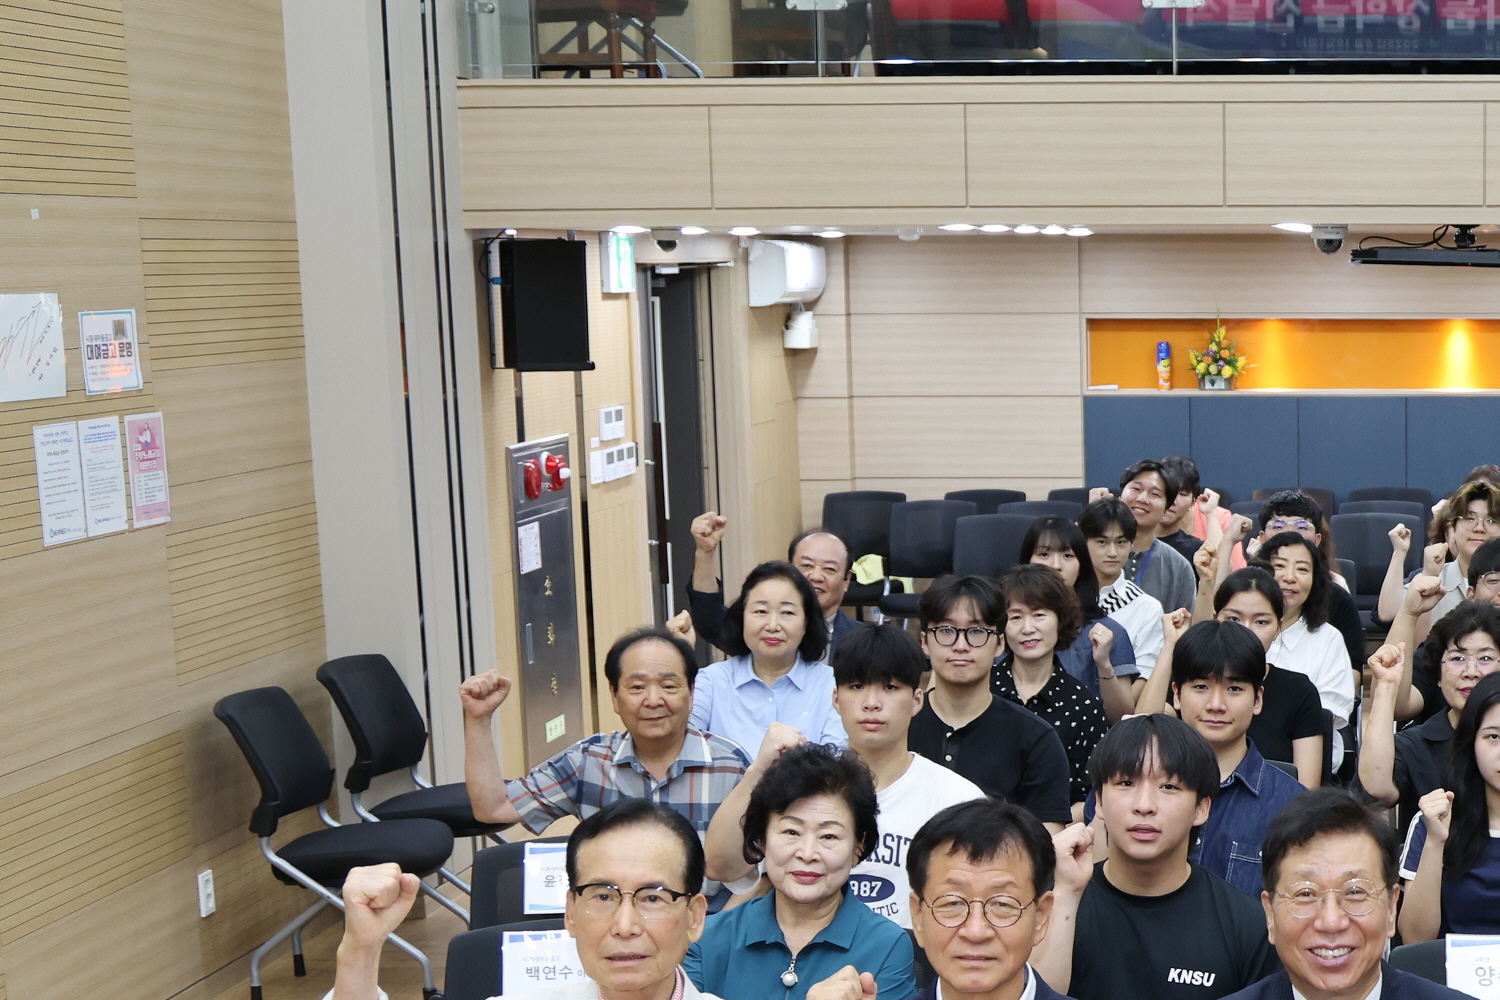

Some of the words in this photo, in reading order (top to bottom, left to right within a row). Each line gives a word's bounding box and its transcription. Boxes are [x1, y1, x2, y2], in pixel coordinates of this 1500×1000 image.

[118, 341, 133, 357] 운영
[526, 965, 573, 981] 백연수
[1167, 967, 1216, 987] KNSU
